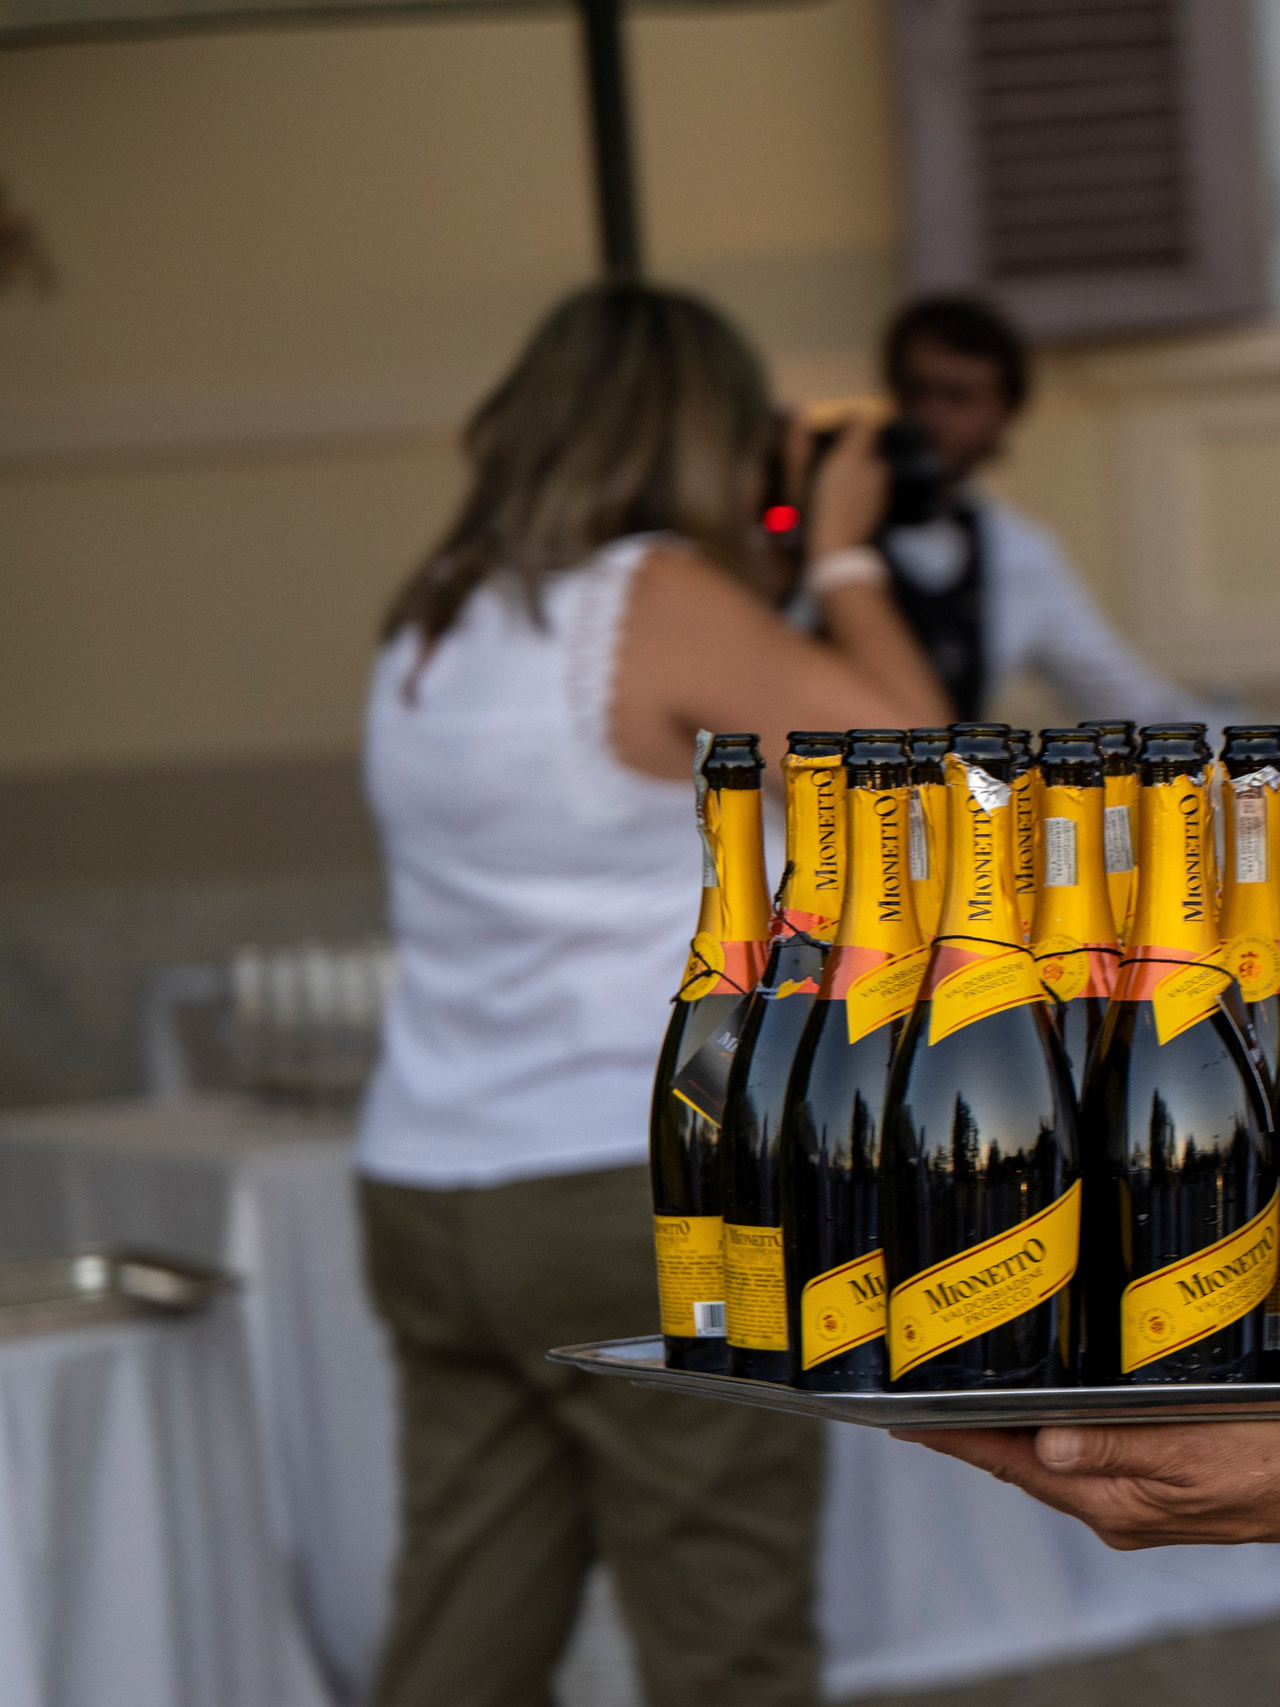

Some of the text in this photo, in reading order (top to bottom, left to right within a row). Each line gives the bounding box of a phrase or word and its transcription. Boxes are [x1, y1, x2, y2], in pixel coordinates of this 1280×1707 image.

[811, 768, 838, 891] MIONETTO
[873, 795, 902, 922] MIONETTO
[1179, 793, 1204, 922] MIONETTO
[923, 1238, 1047, 1315] MIONETTO
[1174, 1226, 1276, 1306] MIONETTO
